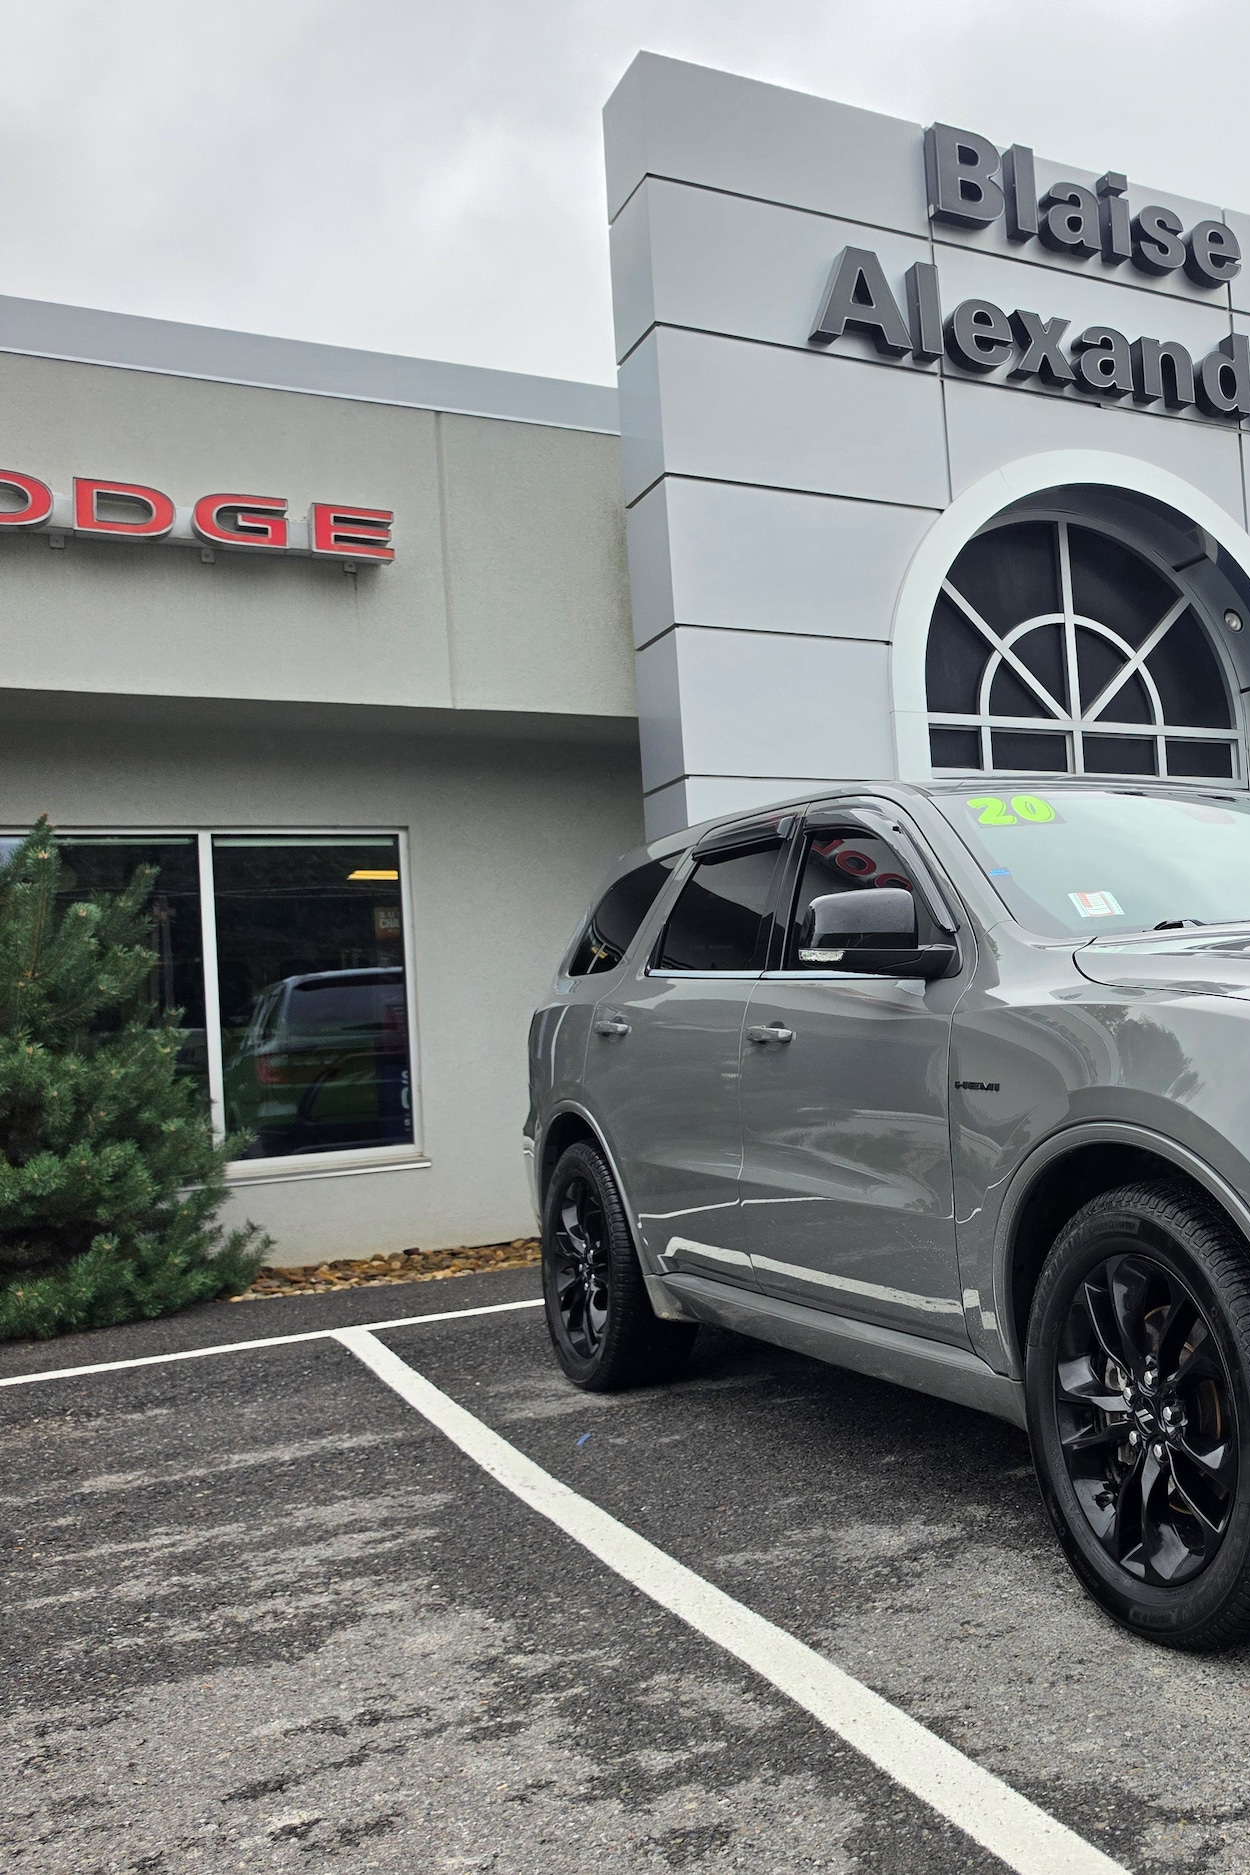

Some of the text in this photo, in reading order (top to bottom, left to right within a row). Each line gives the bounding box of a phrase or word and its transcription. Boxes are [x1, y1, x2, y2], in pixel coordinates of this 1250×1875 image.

[925, 121, 1242, 287] Blaise
[966, 795, 1056, 826] 20
[954, 1081, 1000, 1092] HEMI
